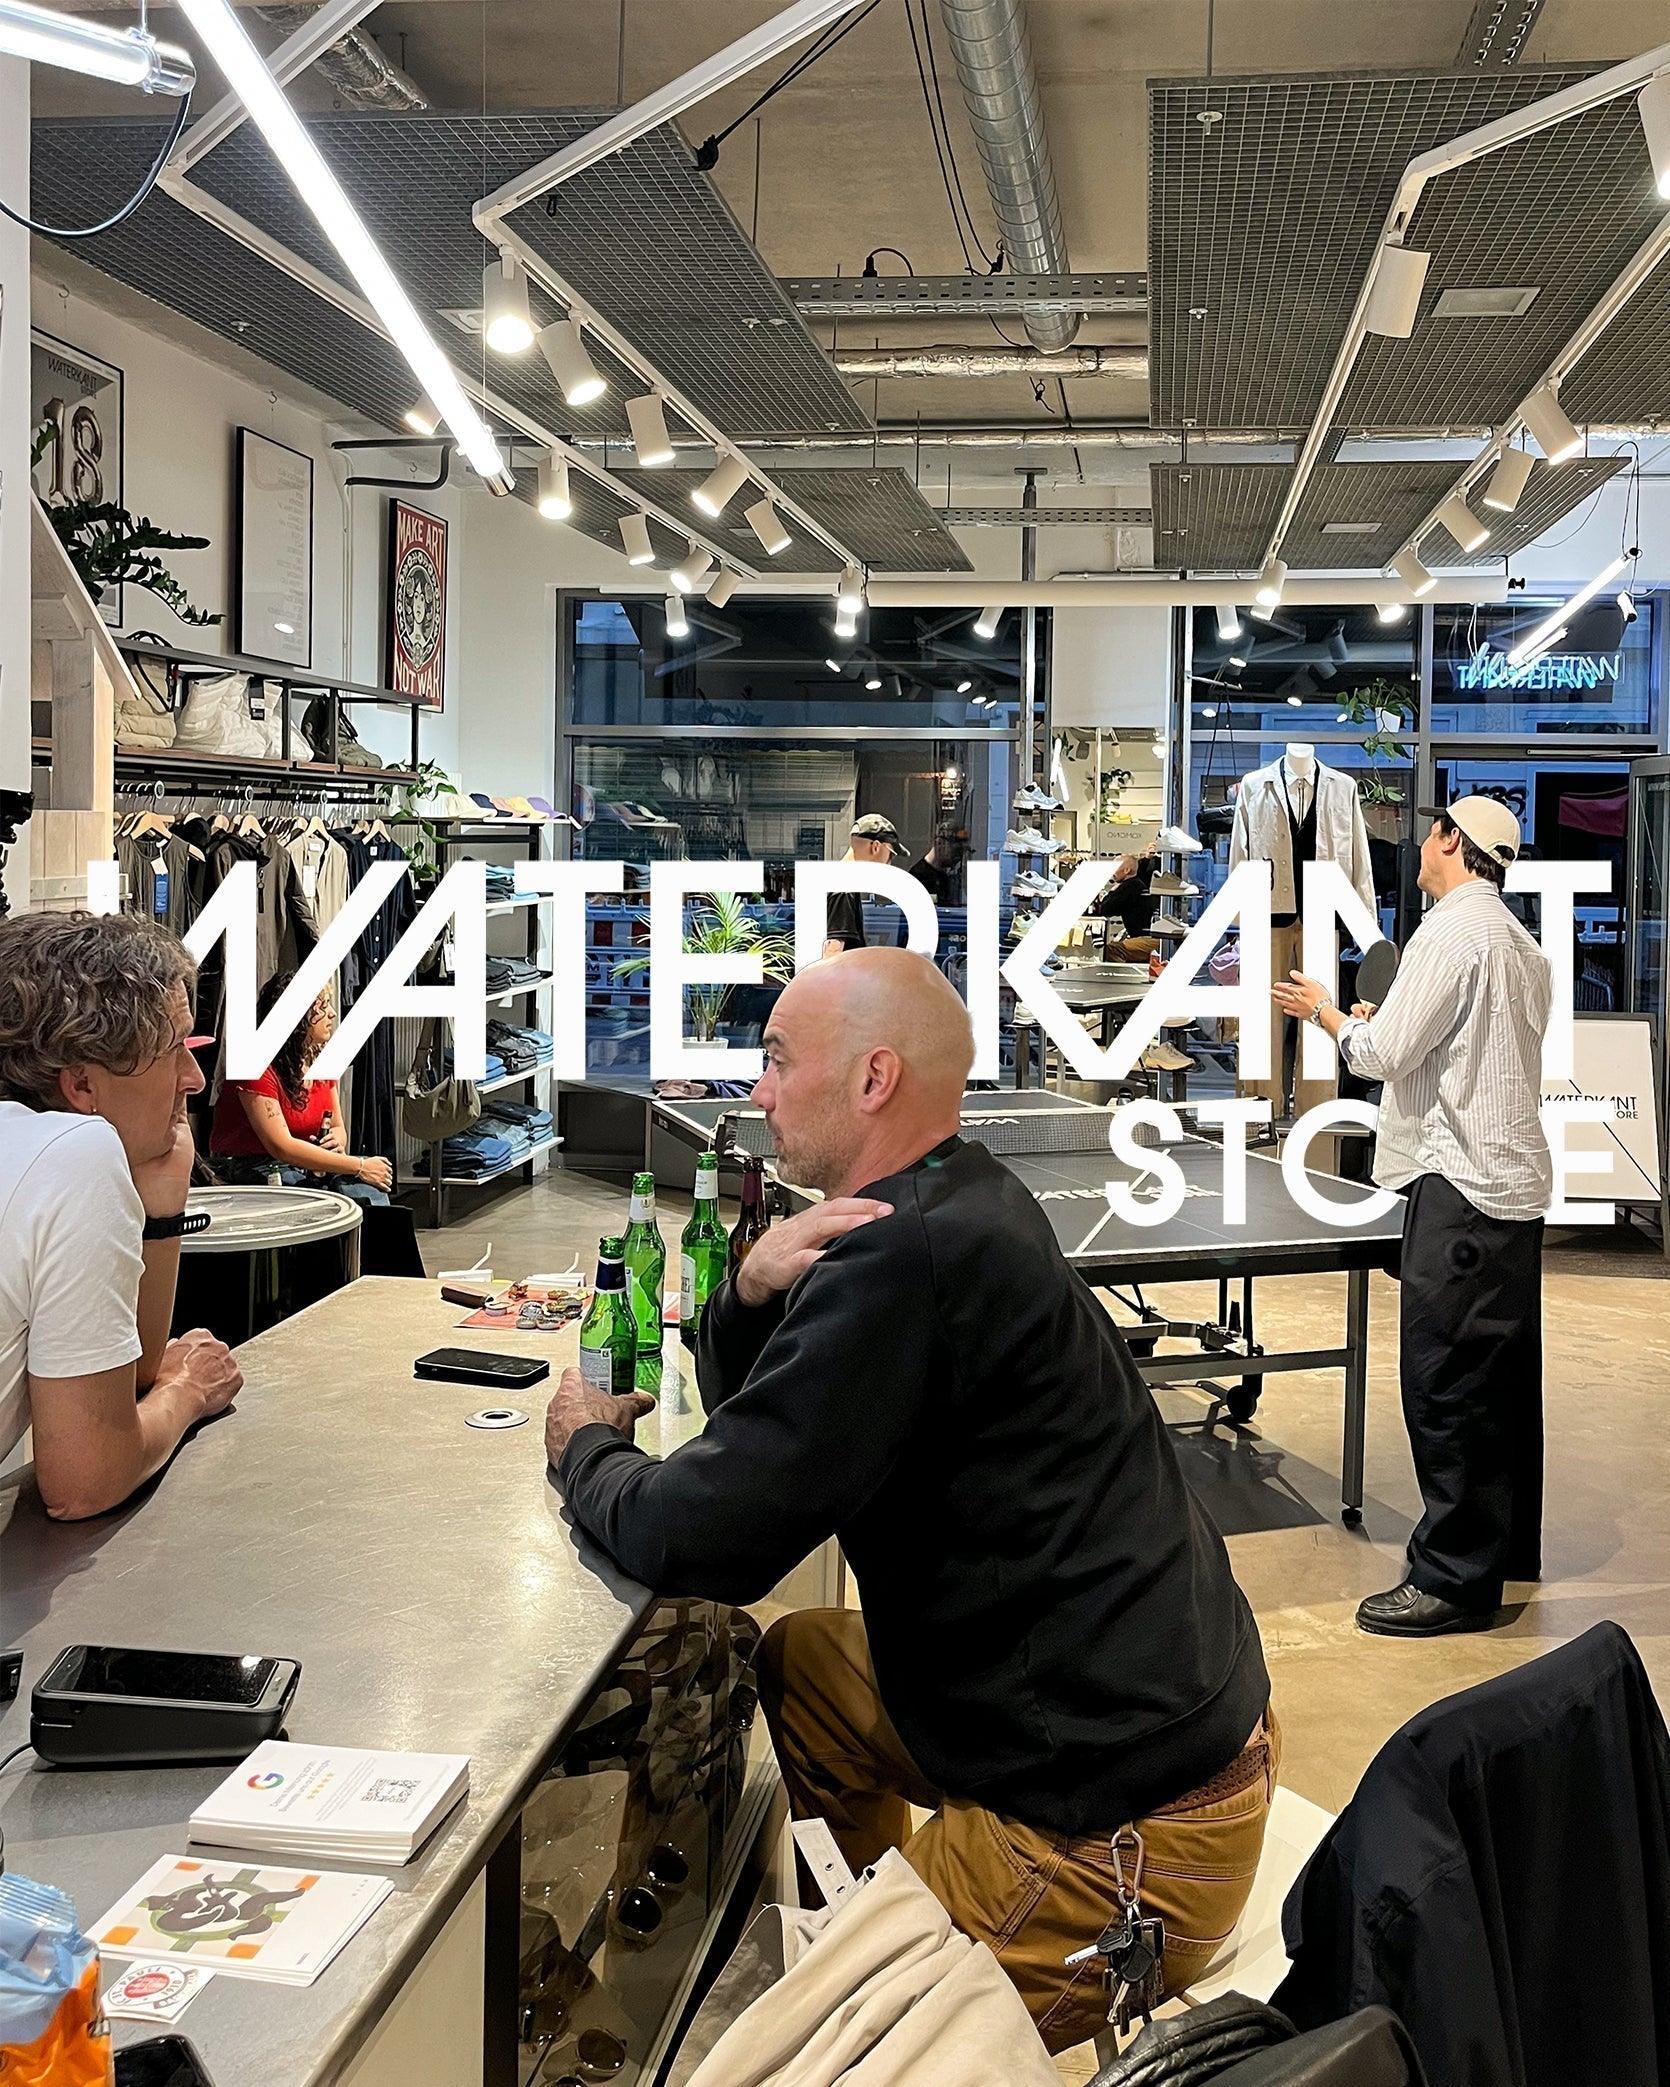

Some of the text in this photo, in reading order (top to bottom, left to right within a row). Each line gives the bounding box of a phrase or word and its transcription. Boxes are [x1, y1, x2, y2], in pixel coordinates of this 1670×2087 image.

[48, 357, 97, 387] WATERKANT
[397, 511, 444, 575] MAKE ART
[393, 640, 440, 698] NOT WAR
